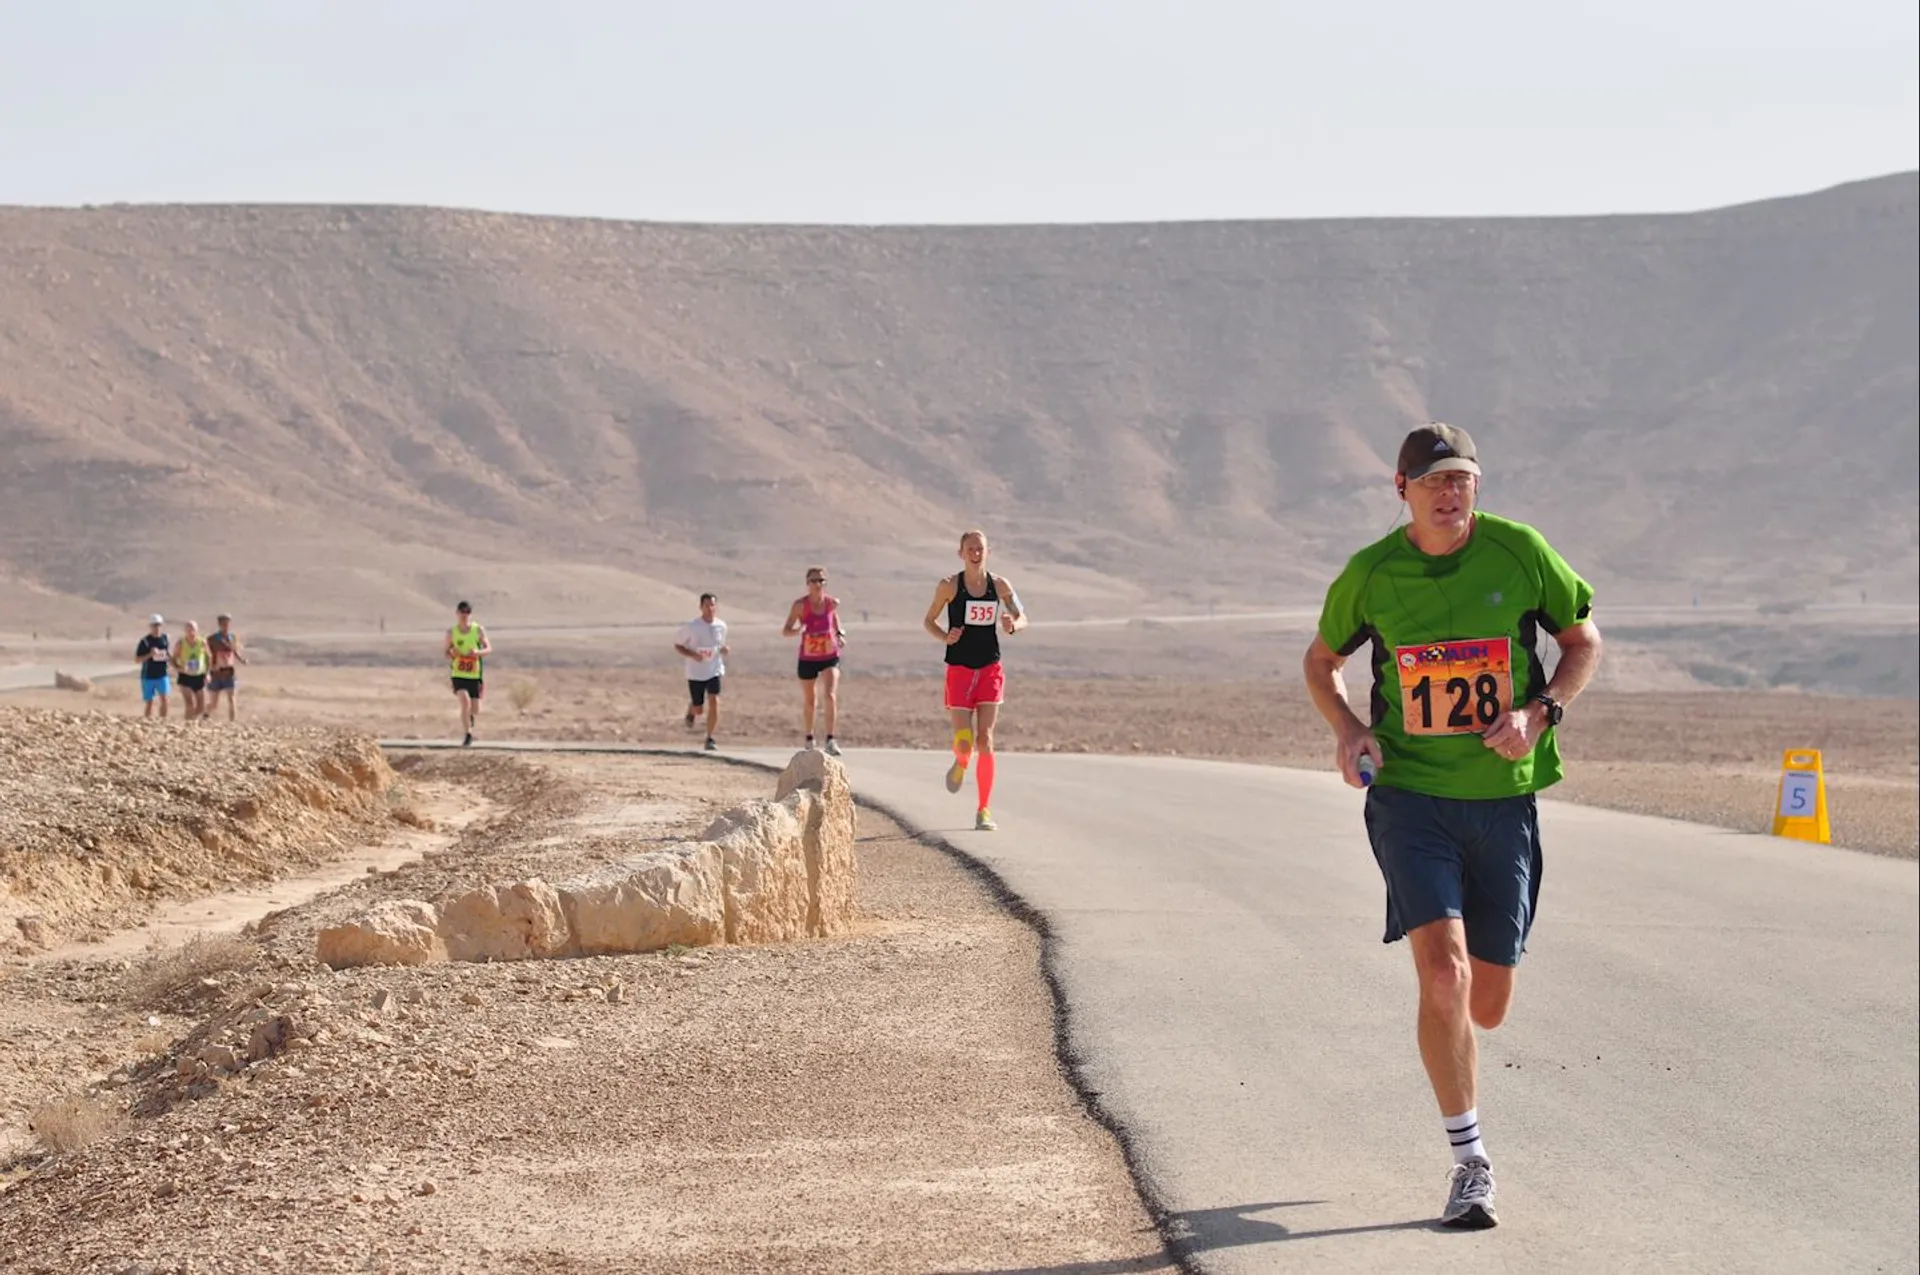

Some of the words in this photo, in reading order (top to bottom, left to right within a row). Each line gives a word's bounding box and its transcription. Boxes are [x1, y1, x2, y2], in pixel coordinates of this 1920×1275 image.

[971, 606, 993, 620] 535
[810, 640, 826, 653] 21
[1417, 645, 1488, 662] RYADH
[1412, 674, 1500, 728] 128
[1791, 787, 1806, 809] 5
